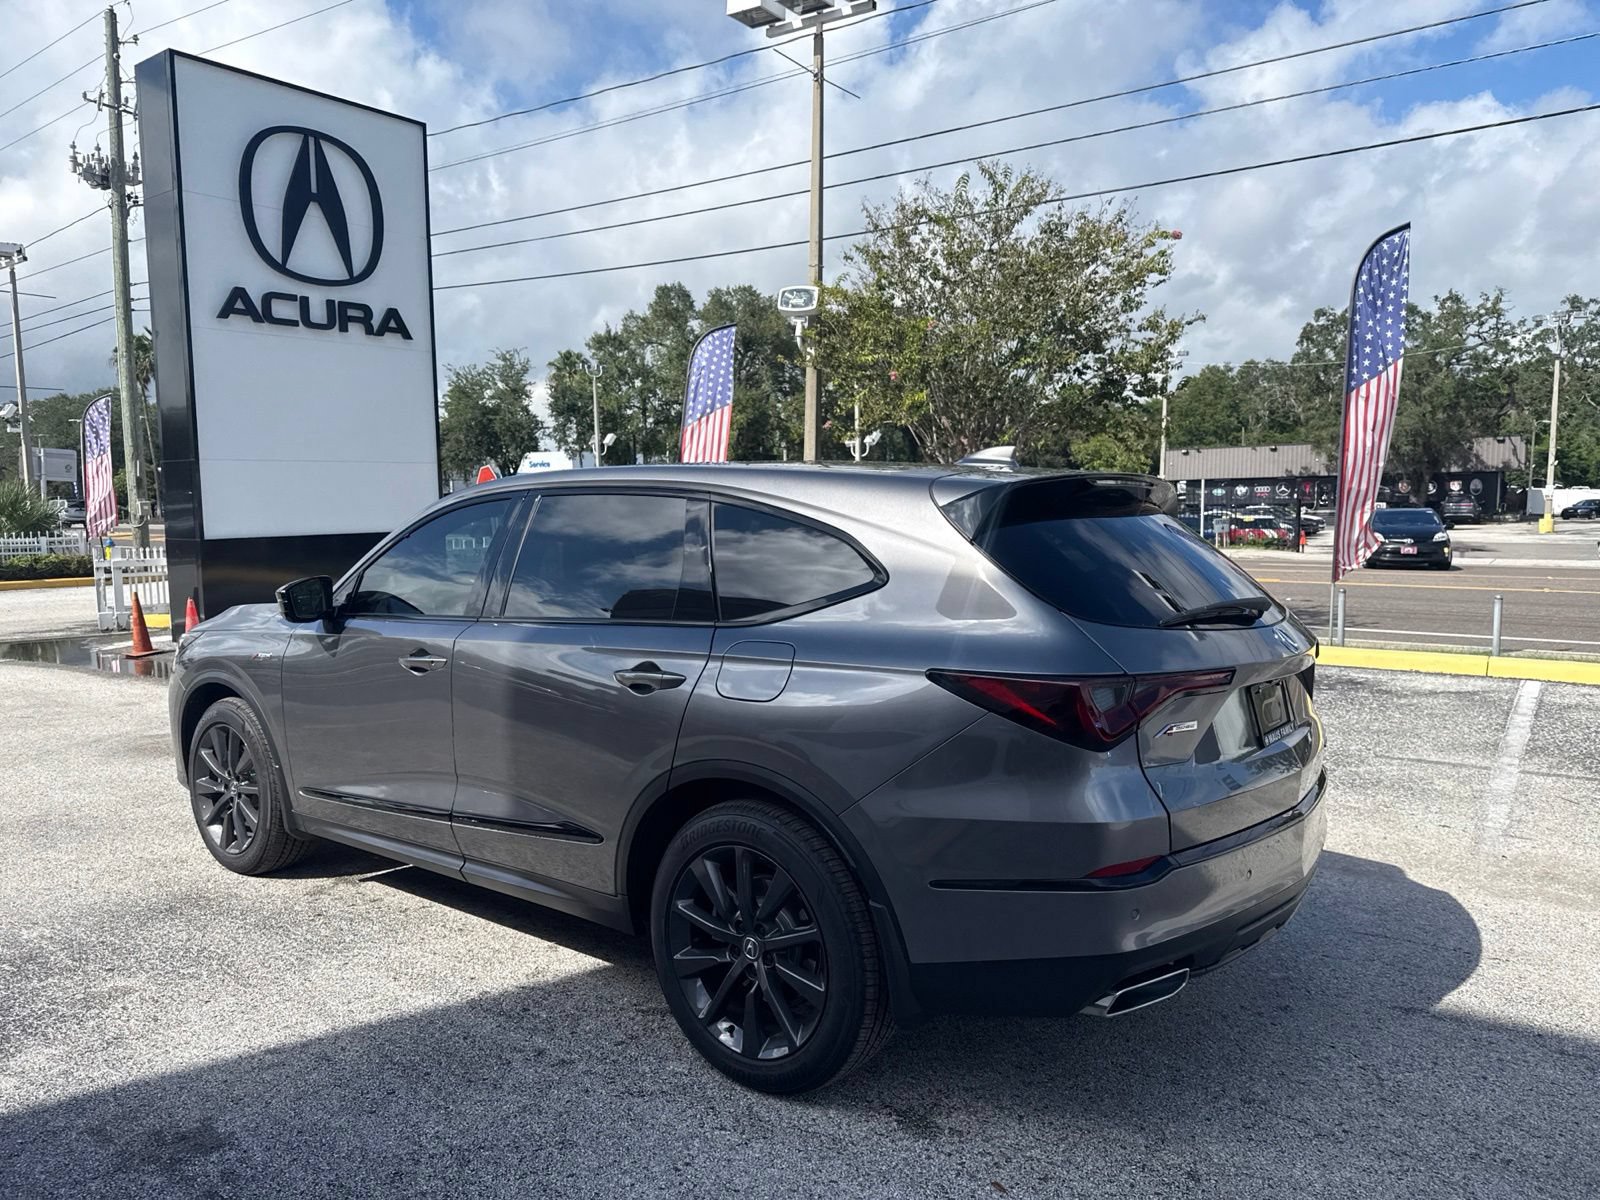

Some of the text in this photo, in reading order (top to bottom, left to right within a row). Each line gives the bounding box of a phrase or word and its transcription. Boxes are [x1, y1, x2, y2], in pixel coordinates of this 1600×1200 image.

[216, 286, 414, 340] ACURA
[529, 460, 551, 468] Service
[680, 819, 767, 850] BRIDGESTONE
